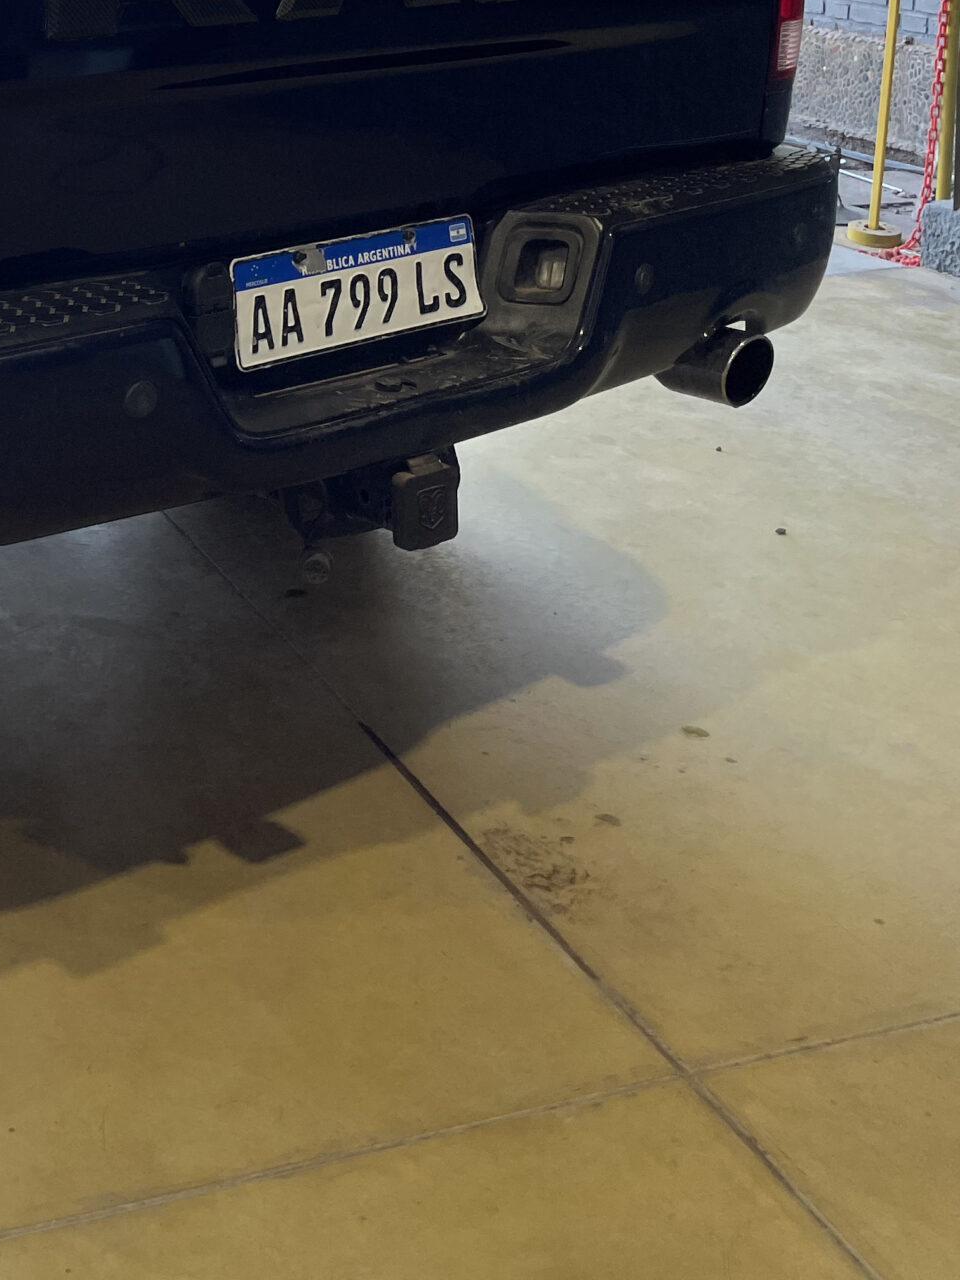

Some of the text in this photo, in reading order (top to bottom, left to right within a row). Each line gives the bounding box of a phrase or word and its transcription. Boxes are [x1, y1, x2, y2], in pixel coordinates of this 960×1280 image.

[300, 243, 412, 277] RBLICA ARGENTINA
[252, 252, 467, 354] AA 799 LS
